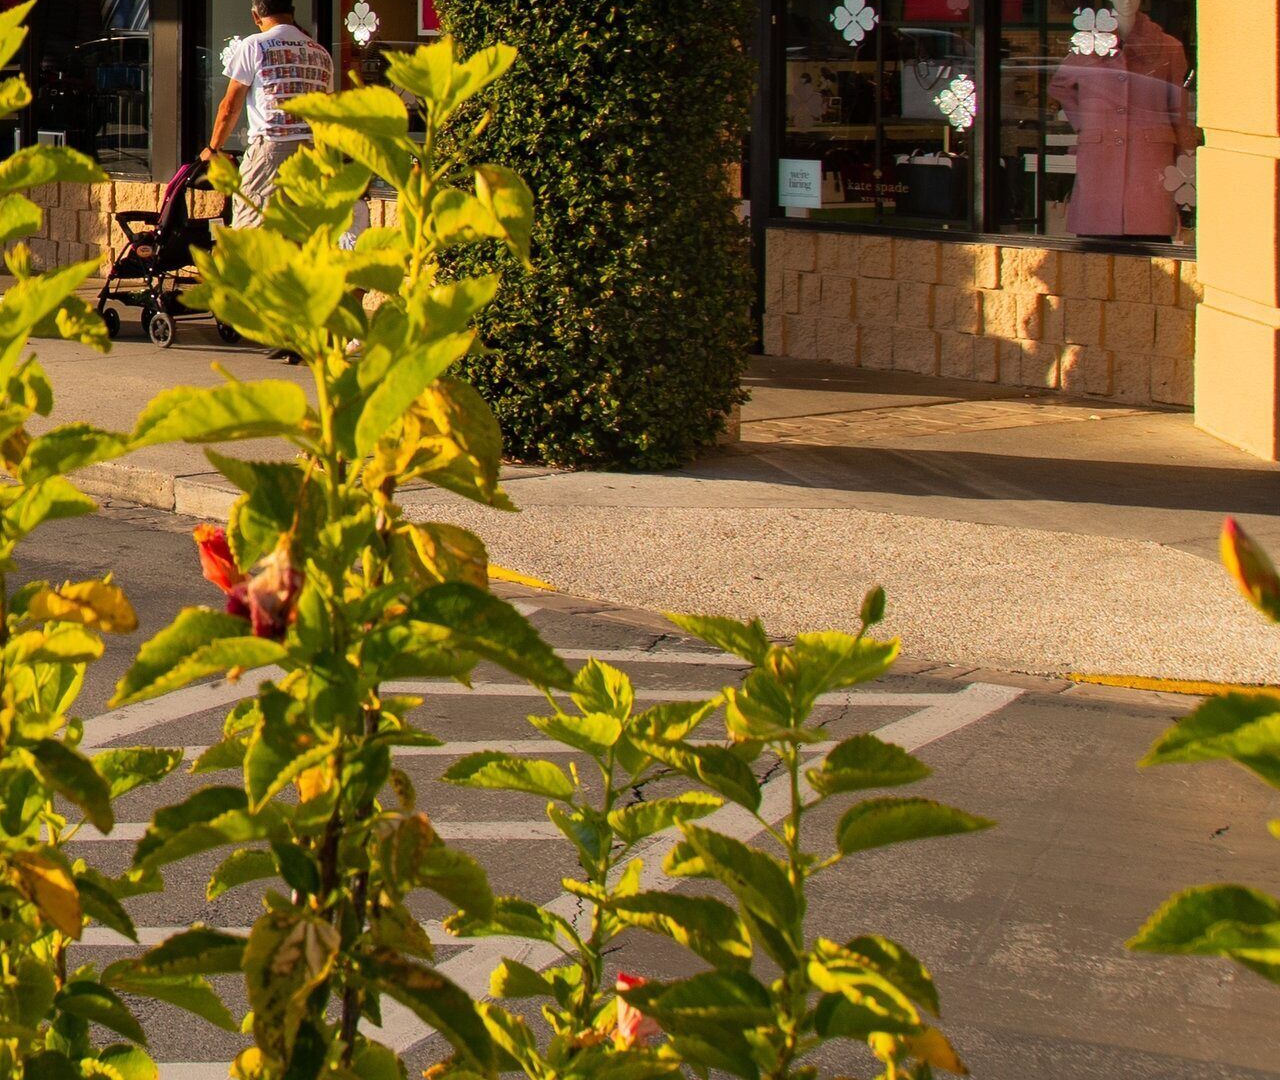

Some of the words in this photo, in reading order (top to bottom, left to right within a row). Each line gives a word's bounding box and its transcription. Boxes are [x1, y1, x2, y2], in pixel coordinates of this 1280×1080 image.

[788, 178, 812, 190] hiring
[847, 179, 872, 191] kate
[875, 182, 910, 195] spade
